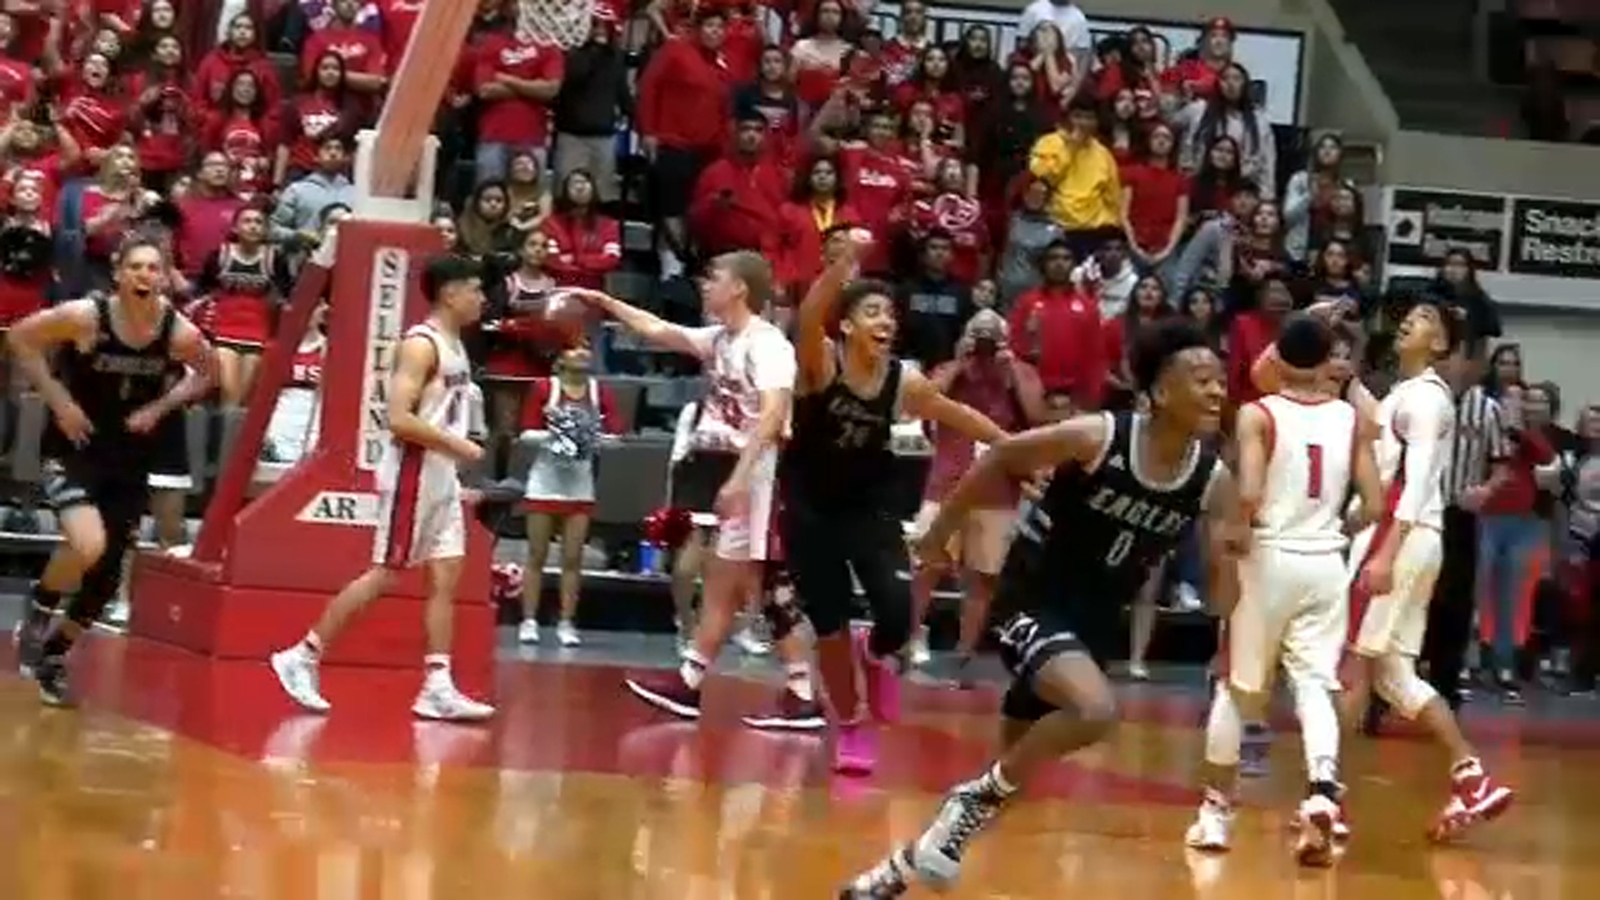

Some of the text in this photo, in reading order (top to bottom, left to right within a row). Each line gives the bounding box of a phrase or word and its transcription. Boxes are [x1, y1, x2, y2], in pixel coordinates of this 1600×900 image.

[366, 251, 399, 464] SELLAND
[1306, 444, 1322, 498] 1
[314, 496, 356, 519] AR
[1106, 531, 1135, 567] 0
